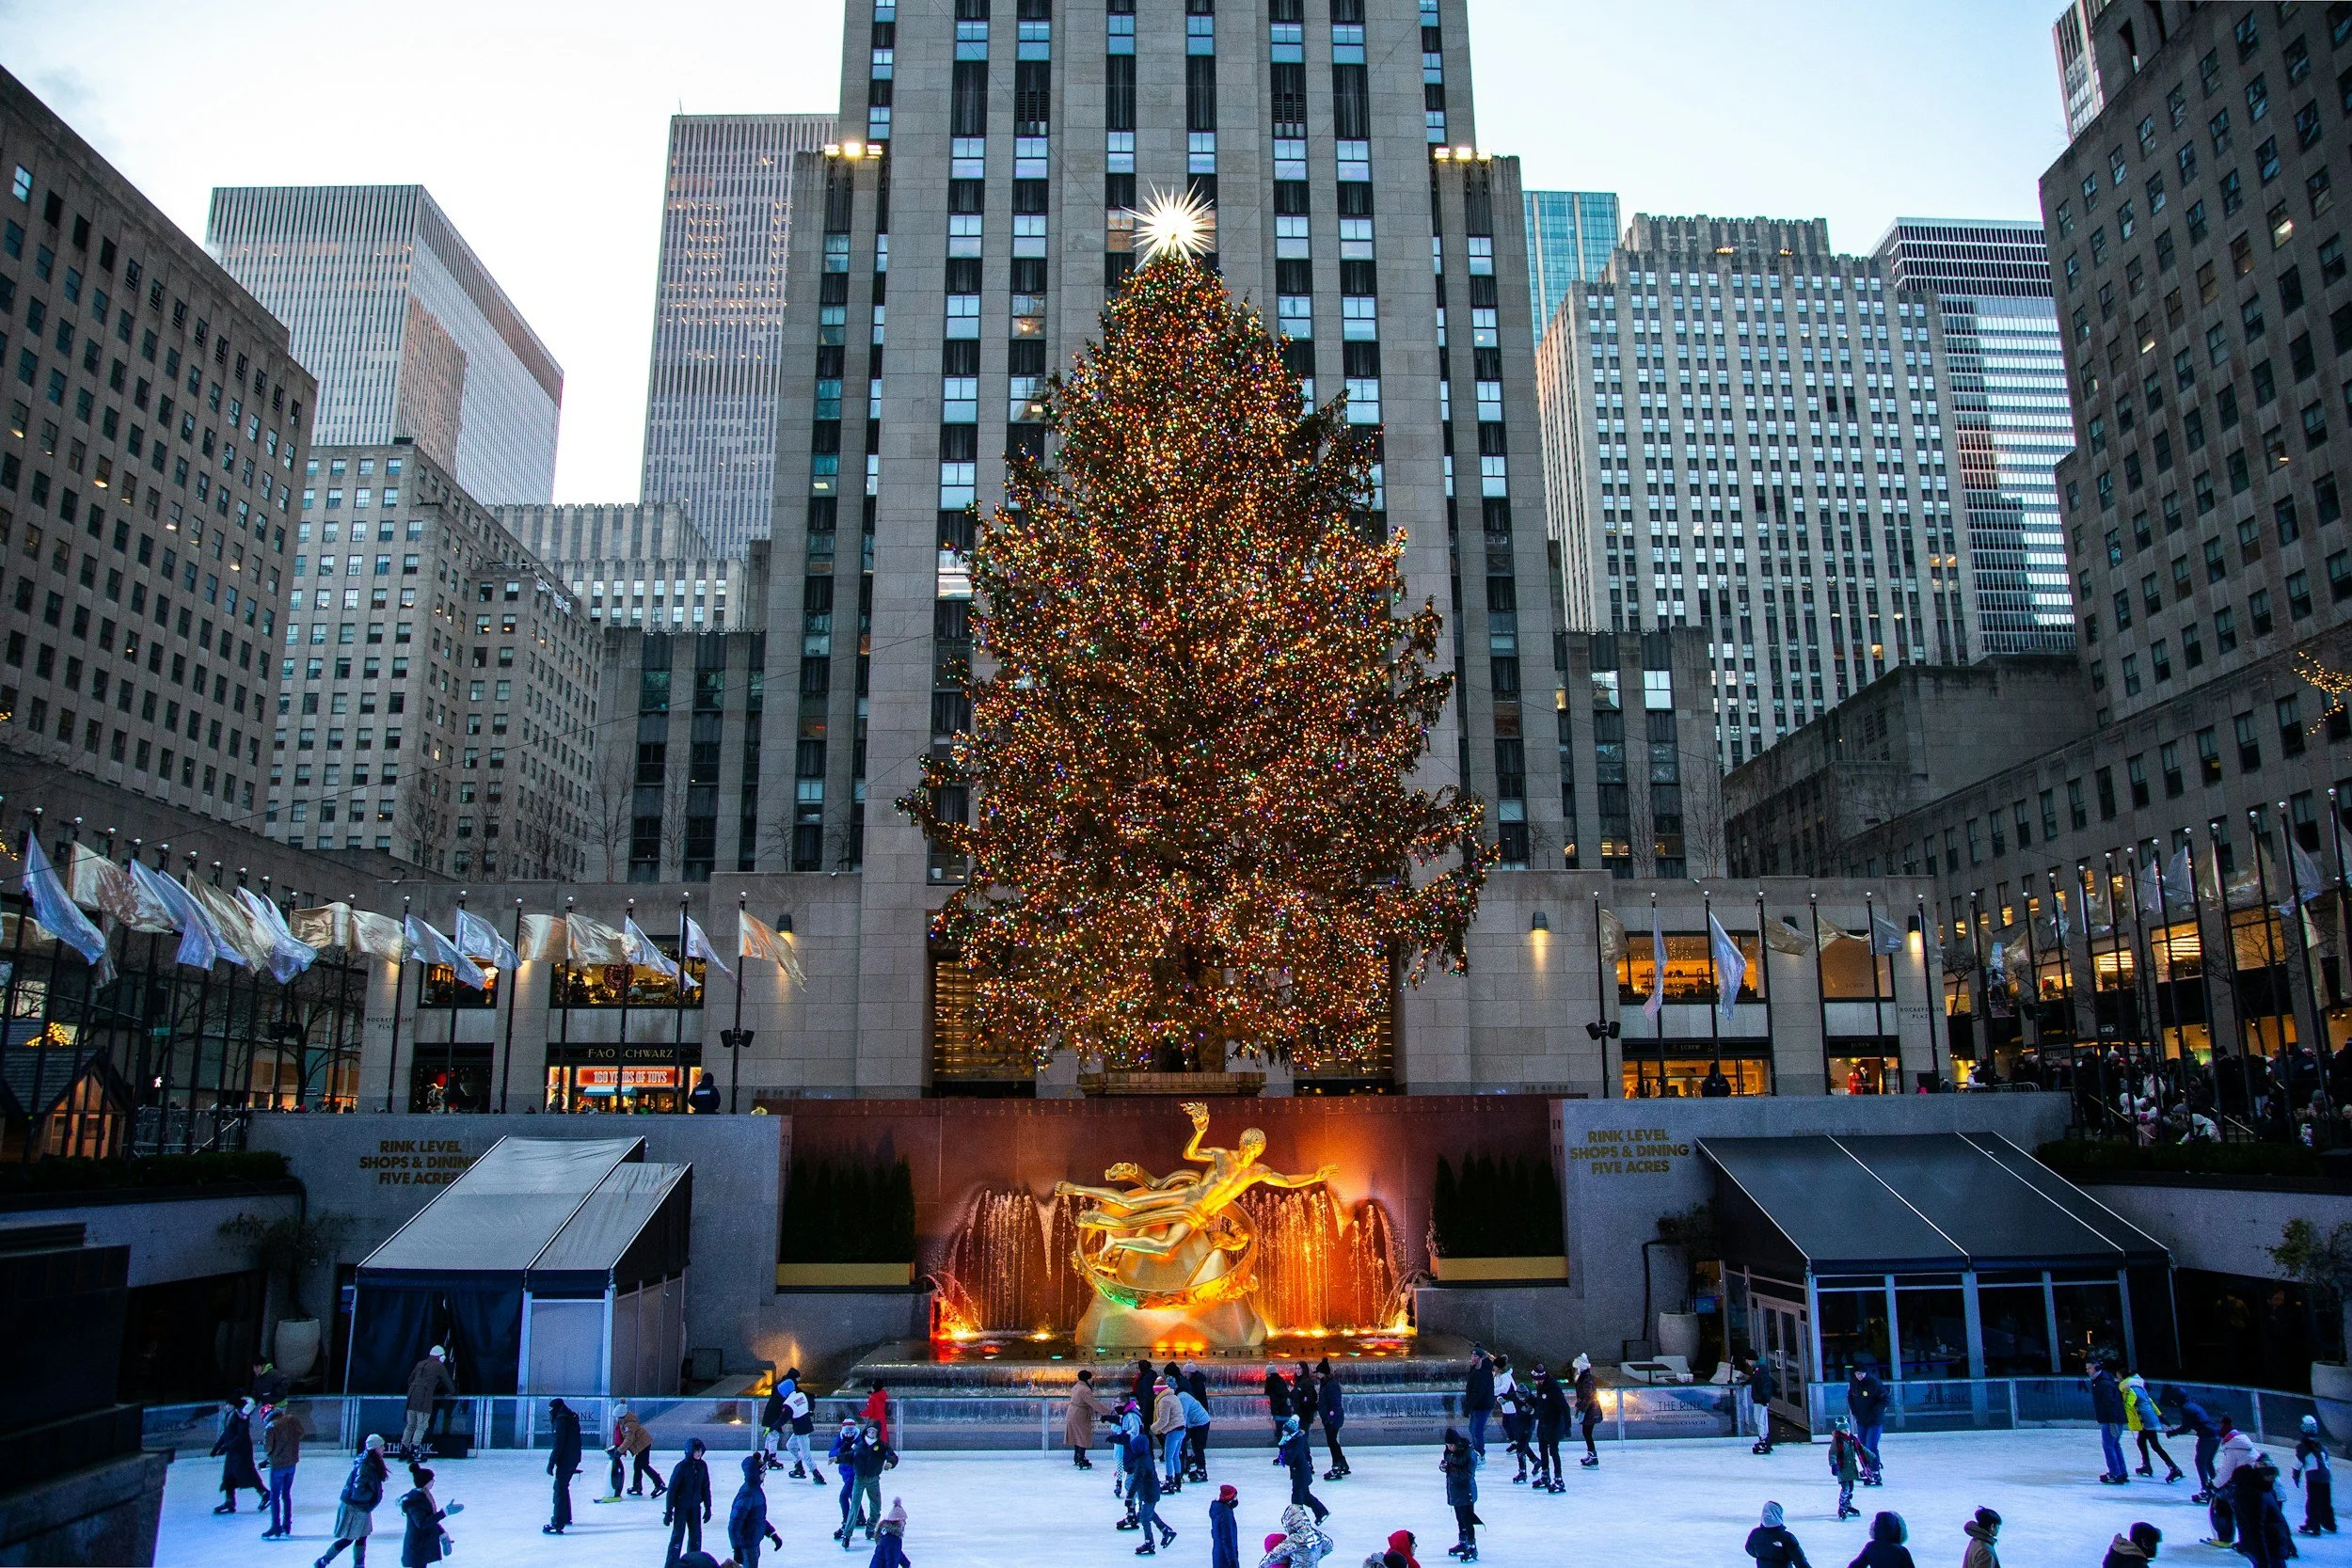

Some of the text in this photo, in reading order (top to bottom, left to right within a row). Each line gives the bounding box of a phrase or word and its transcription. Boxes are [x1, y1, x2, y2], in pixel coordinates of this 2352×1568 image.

[594, 1071, 608, 1083] 160
[636, 1071, 645, 1083] OF
[647, 1071, 667, 1083] TOYS
[1587, 1129, 1669, 1143] RINK LEVEL
[379, 1140, 462, 1153] RINK LEVEL
[1570, 1144, 1690, 1160] SHOPS & DINING
[358, 1156, 409, 1169] SHOPS
[412, 1157, 422, 1168] &
[1591, 1160, 1670, 1175] FIVE ACRES
[378, 1172, 410, 1185] FIVE
[1385, 1406, 1431, 1418] THE RINK
[1658, 1400, 1703, 1411] THE RINK
